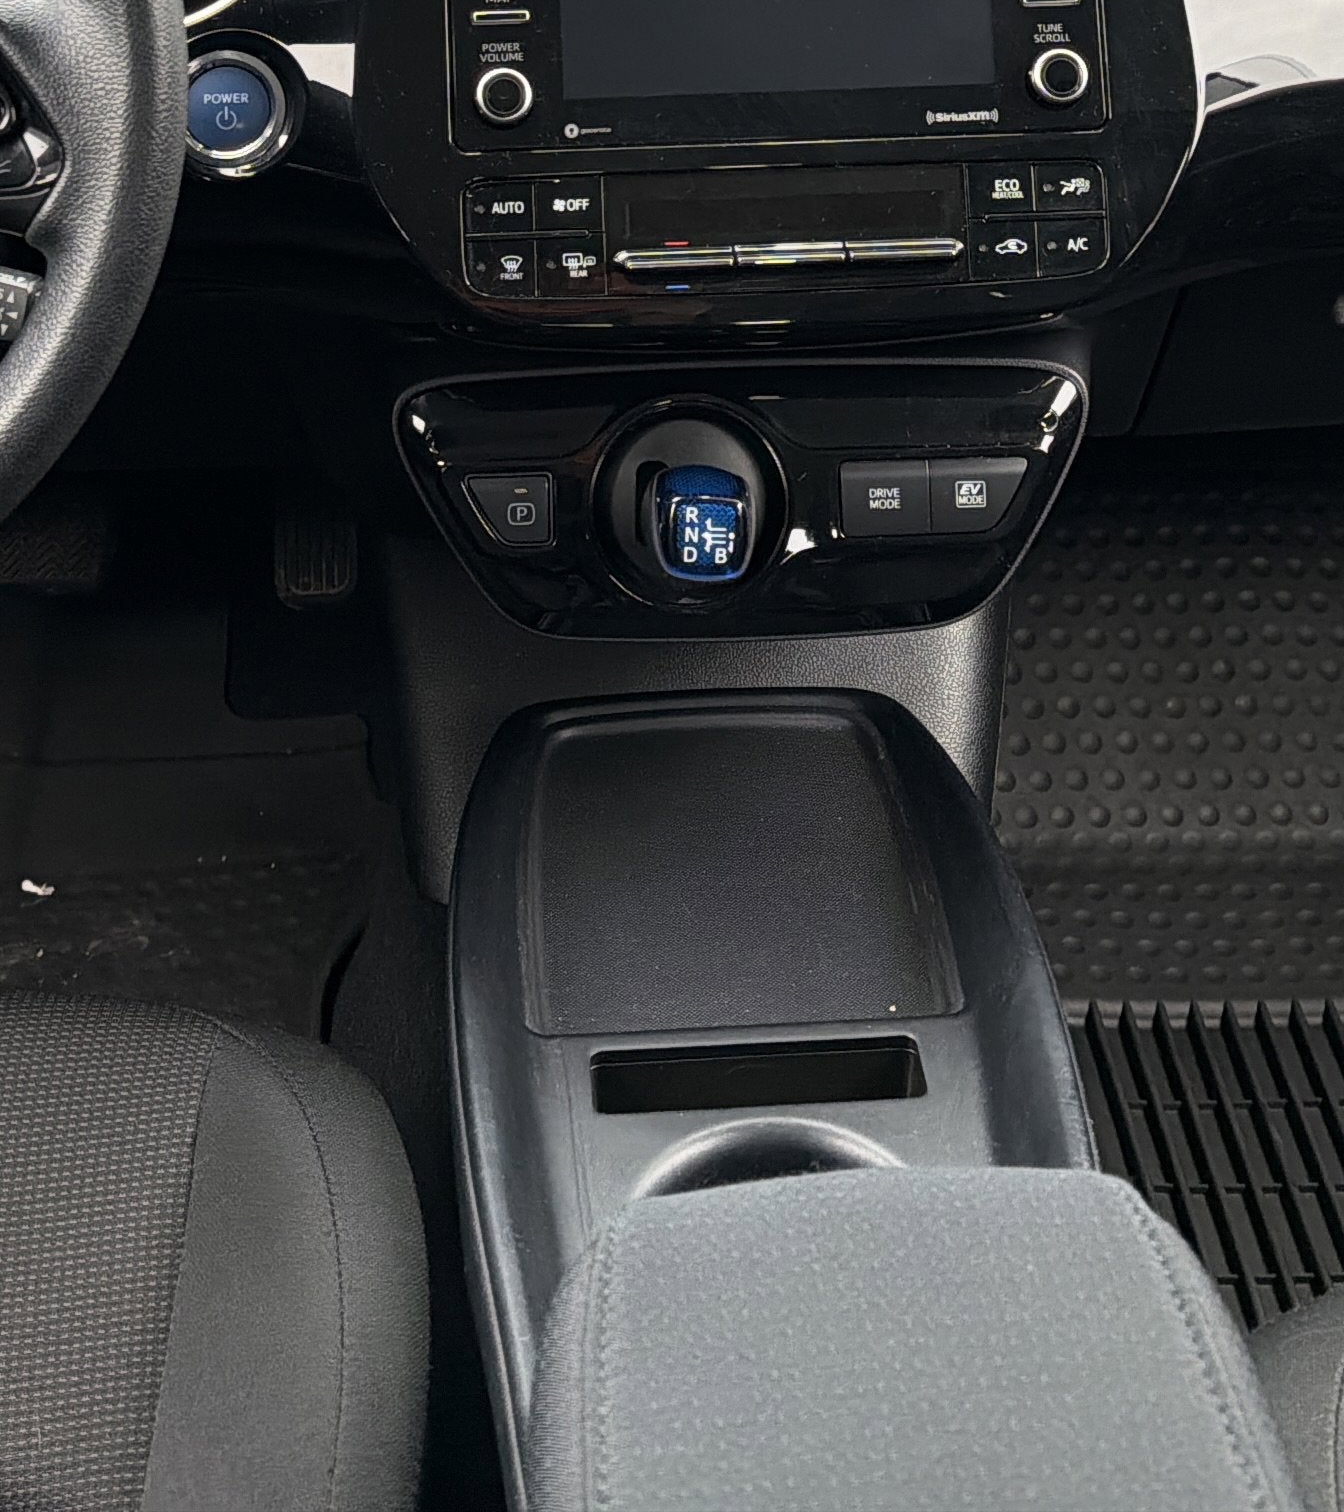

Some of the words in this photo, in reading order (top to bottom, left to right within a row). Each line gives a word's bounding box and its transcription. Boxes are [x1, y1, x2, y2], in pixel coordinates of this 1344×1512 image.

[1037, 23, 1064, 33] TUNE
[1033, 33, 1071, 44] SCROLL
[481, 42, 521, 53] POWER
[479, 52, 525, 63] VOLUME
[203, 92, 249, 105] POWER
[994, 178, 1020, 192] ECO
[491, 201, 525, 215] AUTO
[566, 198, 590, 212] OFF
[1067, 237, 1089, 252] A/C
[500, 272, 525, 281] FRONT
[569, 269, 589, 278] REAR
[868, 487, 901, 499] DRIVE
[959, 483, 982, 495] EV
[869, 498, 902, 510] MODE
[958, 494, 985, 505] MODE
[685, 506, 699, 524] R
[684, 526, 699, 543] N
[683, 546, 698, 563] D
[714, 547, 728, 564] B
